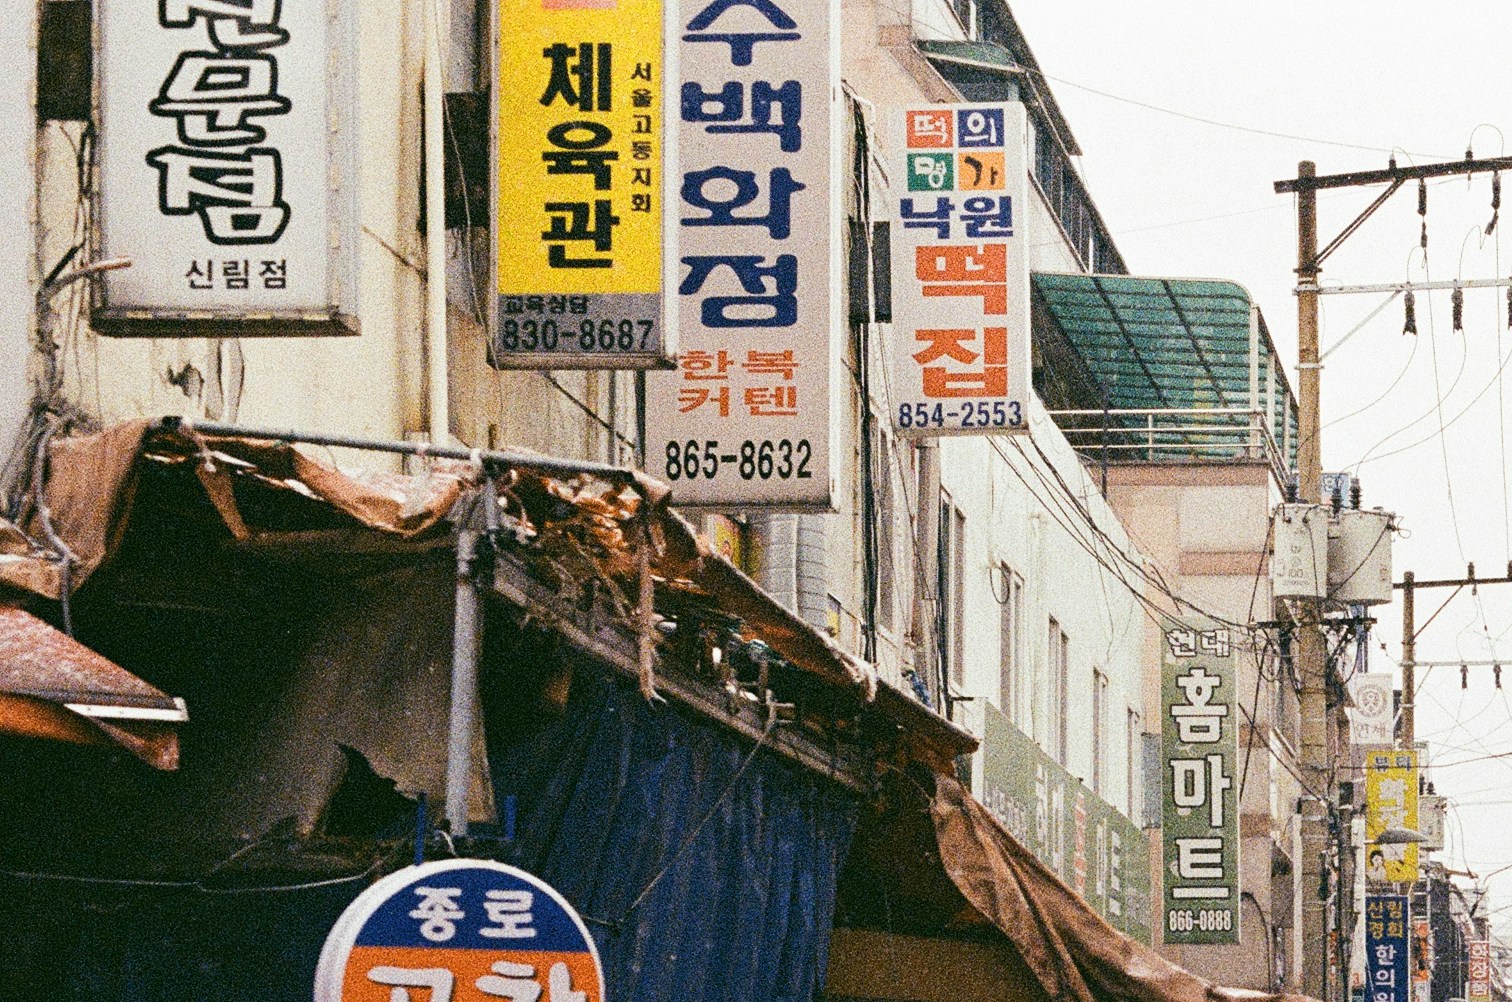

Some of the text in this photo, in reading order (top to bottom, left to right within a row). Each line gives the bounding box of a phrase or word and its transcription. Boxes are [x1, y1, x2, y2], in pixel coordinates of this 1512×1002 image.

[540, 43, 620, 269] 체육관
[909, 153, 1003, 190] 명가
[901, 196, 1014, 239] 낙원
[186, 259, 287, 290] 신림점
[502, 319, 655, 351] 830-8687
[911, 244, 1008, 398] 떡집
[679, 349, 800, 382] 한복
[678, 386, 799, 417] 커텐
[900, 401, 1023, 428] 854-2553
[665, 439, 813, 482] 865-8632
[1165, 628, 1231, 658] 현대
[1170, 667, 1232, 899] 홈마트
[409, 887, 538, 942] 종로
[1168, 908, 1232, 932] 866-0888
